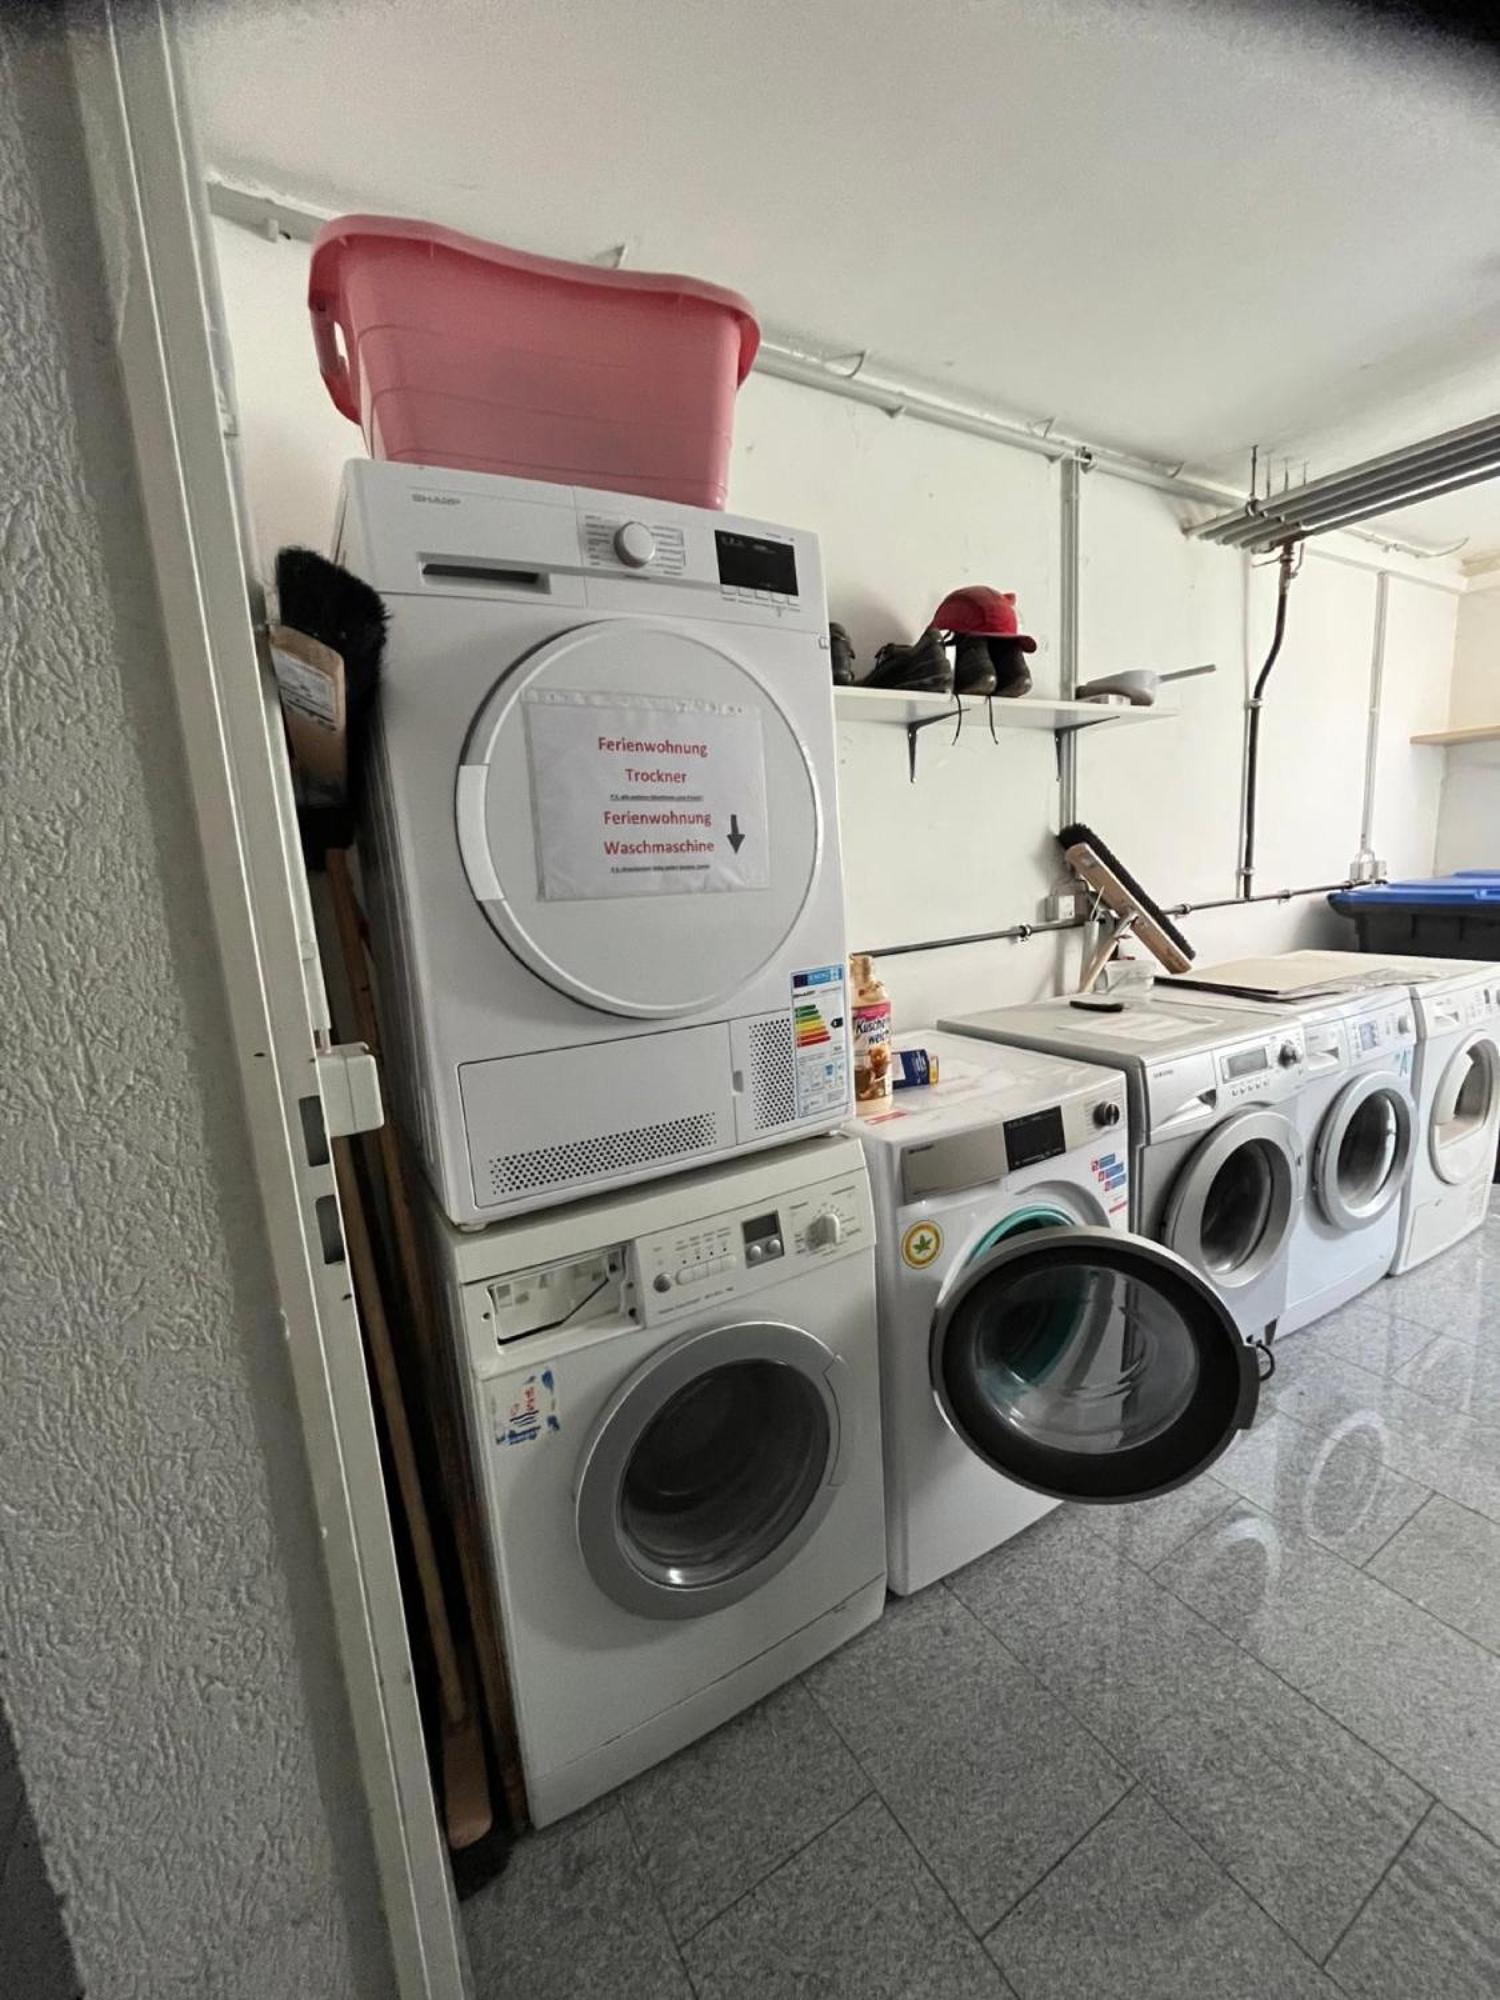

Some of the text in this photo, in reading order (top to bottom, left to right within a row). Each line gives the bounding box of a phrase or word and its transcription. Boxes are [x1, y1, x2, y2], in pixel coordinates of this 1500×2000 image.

[598, 736, 708, 758] Ferienwohnung
[625, 768, 687, 784] Trockner
[603, 811, 712, 827] Ferienwohnung
[603, 839, 715, 855] Waschmaschine
